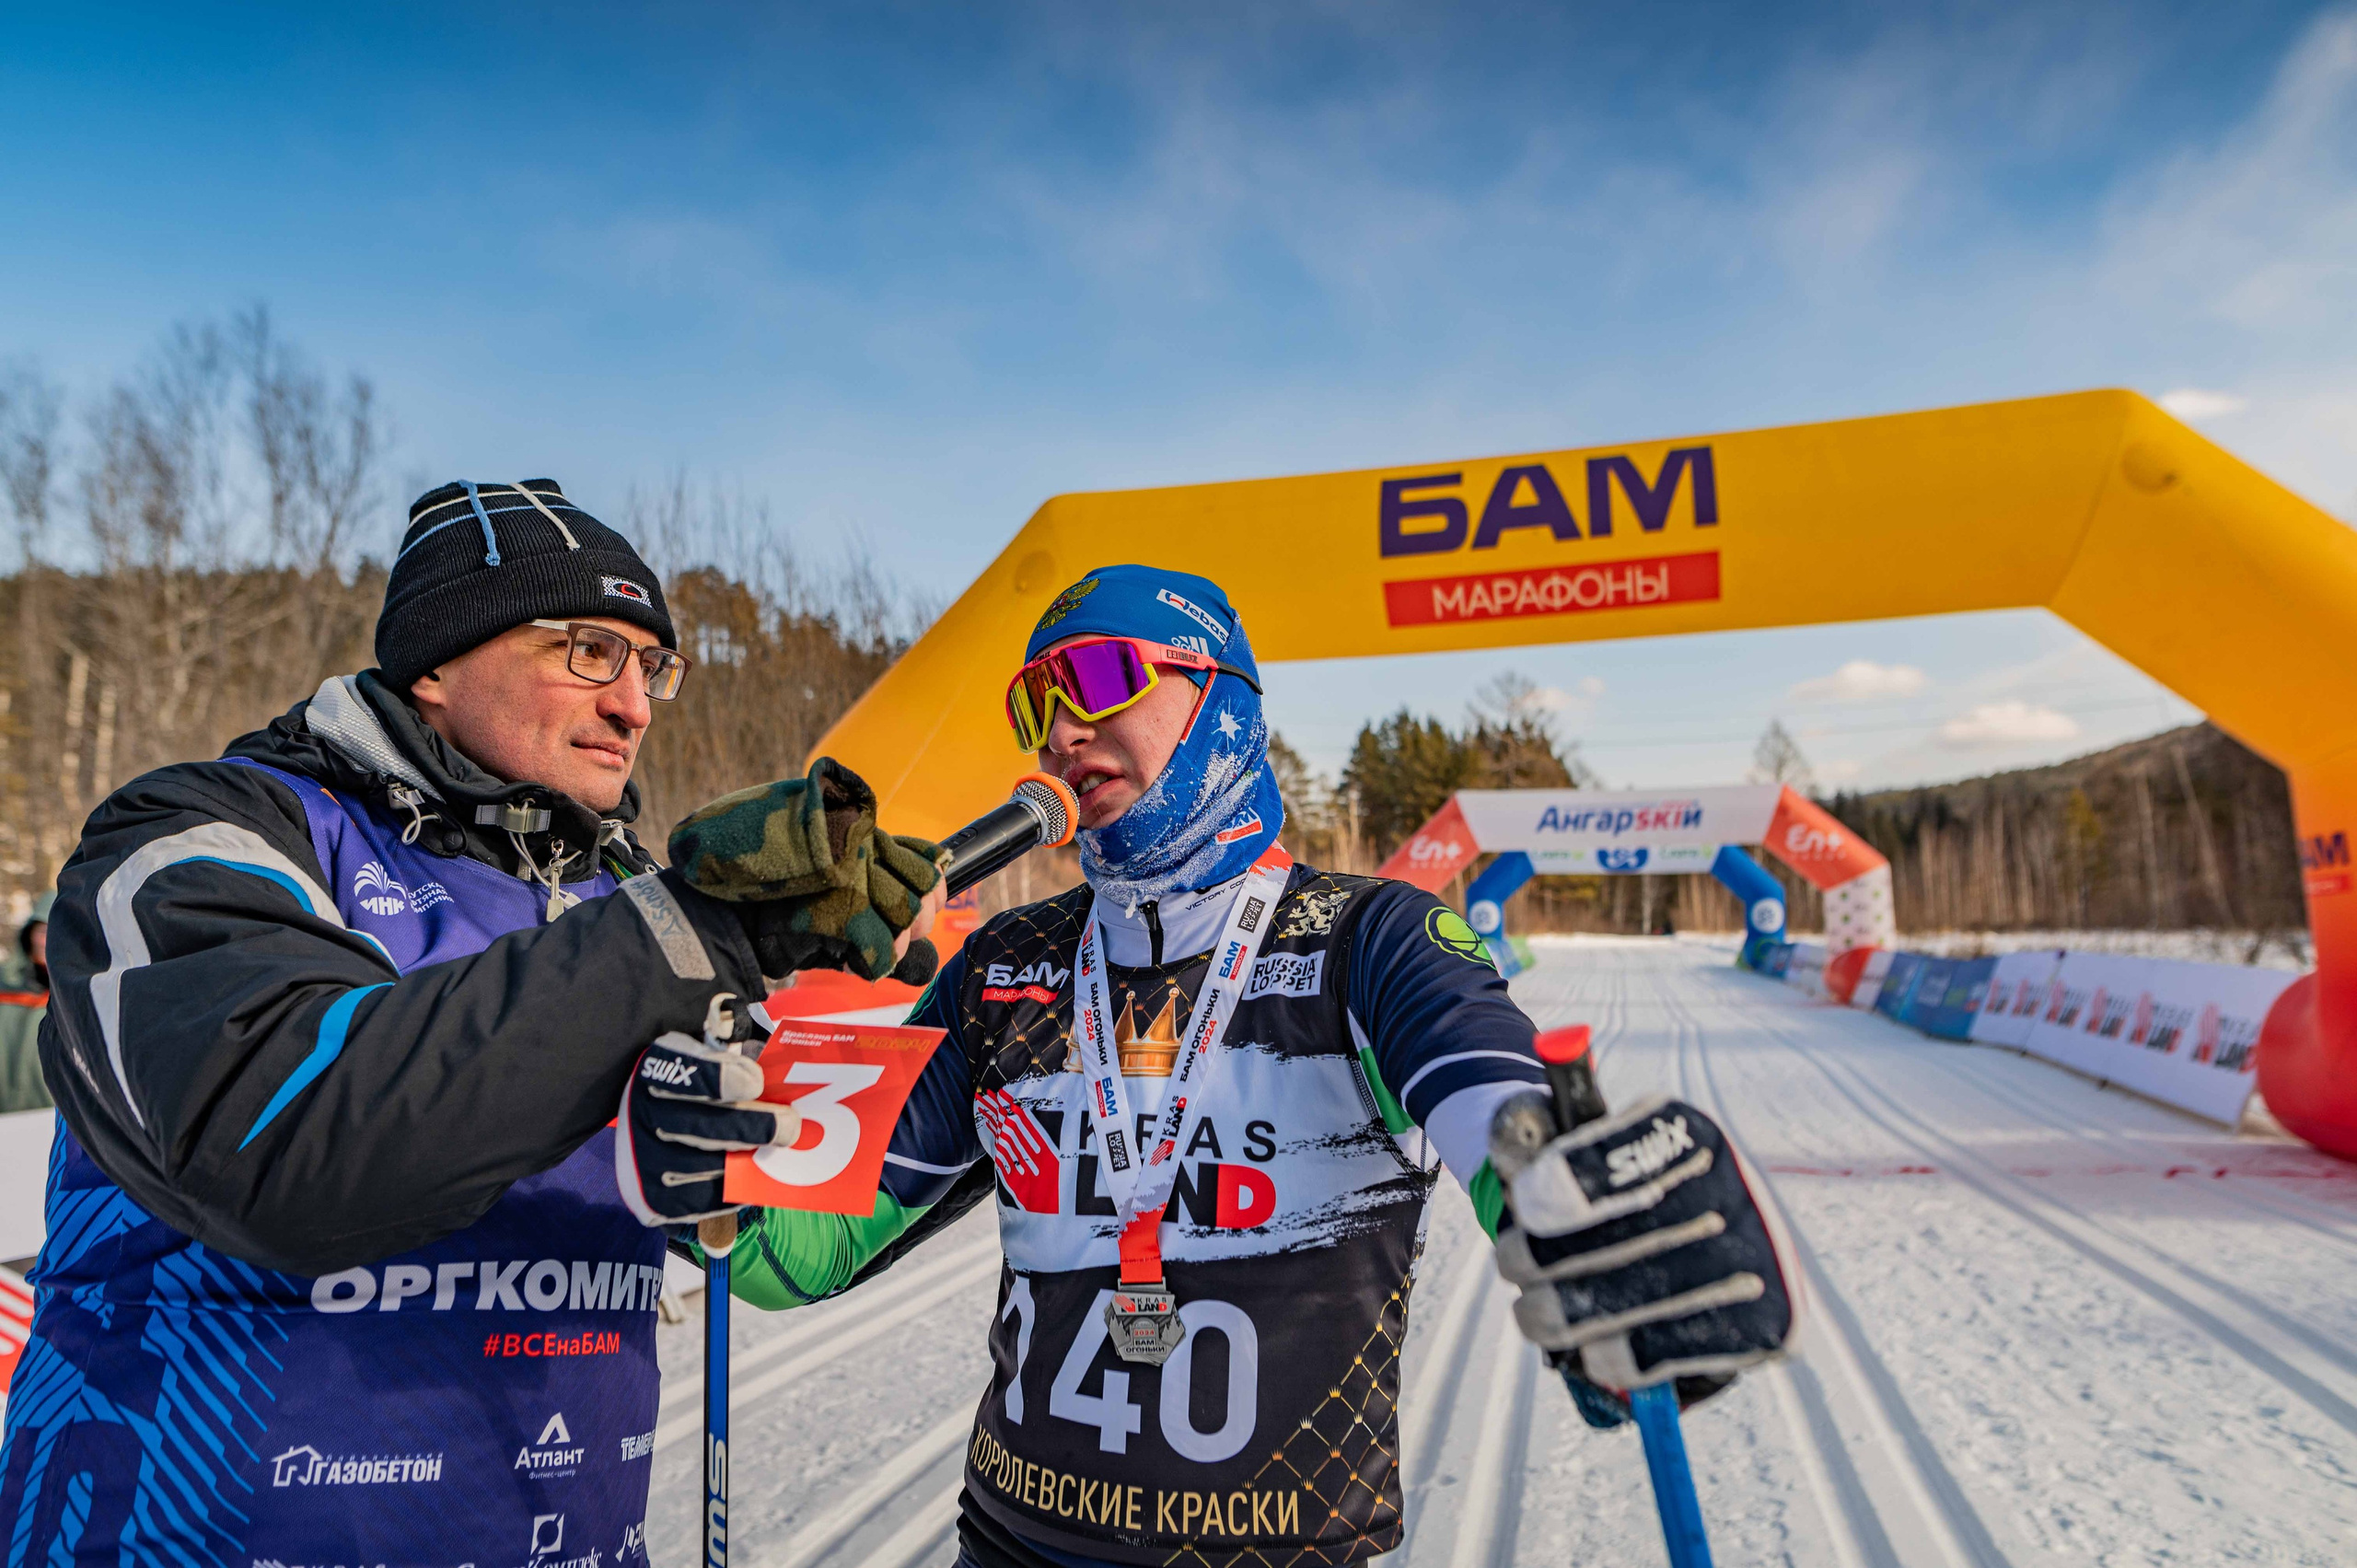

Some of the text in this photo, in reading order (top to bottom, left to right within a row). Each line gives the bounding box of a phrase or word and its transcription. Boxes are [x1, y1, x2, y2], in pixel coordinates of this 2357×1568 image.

[1379, 445, 1719, 559] БАМ
[1432, 562, 1670, 621] МАРАФОНЫ
[359, 896, 405, 916] ИНК
[1185, 889, 1225, 911] VICTORY
[1240, 900, 1258, 928] RUSSIA
[985, 961, 1071, 989] БАМ
[1082, 947, 1090, 977] LAND
[1219, 941, 1241, 979] БАМ
[1253, 958, 1318, 980] RUSSIA
[1249, 974, 1316, 994] LOPPET
[832, 1033, 855, 1043] БАМ
[1085, 1009, 1095, 1041] 2024
[1090, 981, 1108, 1066] БАМ ОГОНЬКИ
[1179, 989, 1220, 1082] БАМ ОГОНЬКИ
[1199, 1020, 1217, 1054] 2024
[1102, 1076, 1118, 1117] БАМ
[751, 1062, 886, 1187] 3
[1162, 1095, 1178, 1135] KRAS
[1168, 1097, 1187, 1137] LAND
[1114, 1132, 1127, 1168] RUSSIA
[1075, 1155, 1276, 1228] LND
[1138, 1303, 1167, 1313] LAND
[483, 1332, 621, 1358] #ВСЕнаБАМ
[1002, 1272, 1259, 1463] 140
[313, 1458, 443, 1485] ГАЗОБЕТОН
[514, 1446, 585, 1470] Атлант
[970, 1423, 1299, 1536] КОРОЛЕВСКИЕ КРАСКИ
